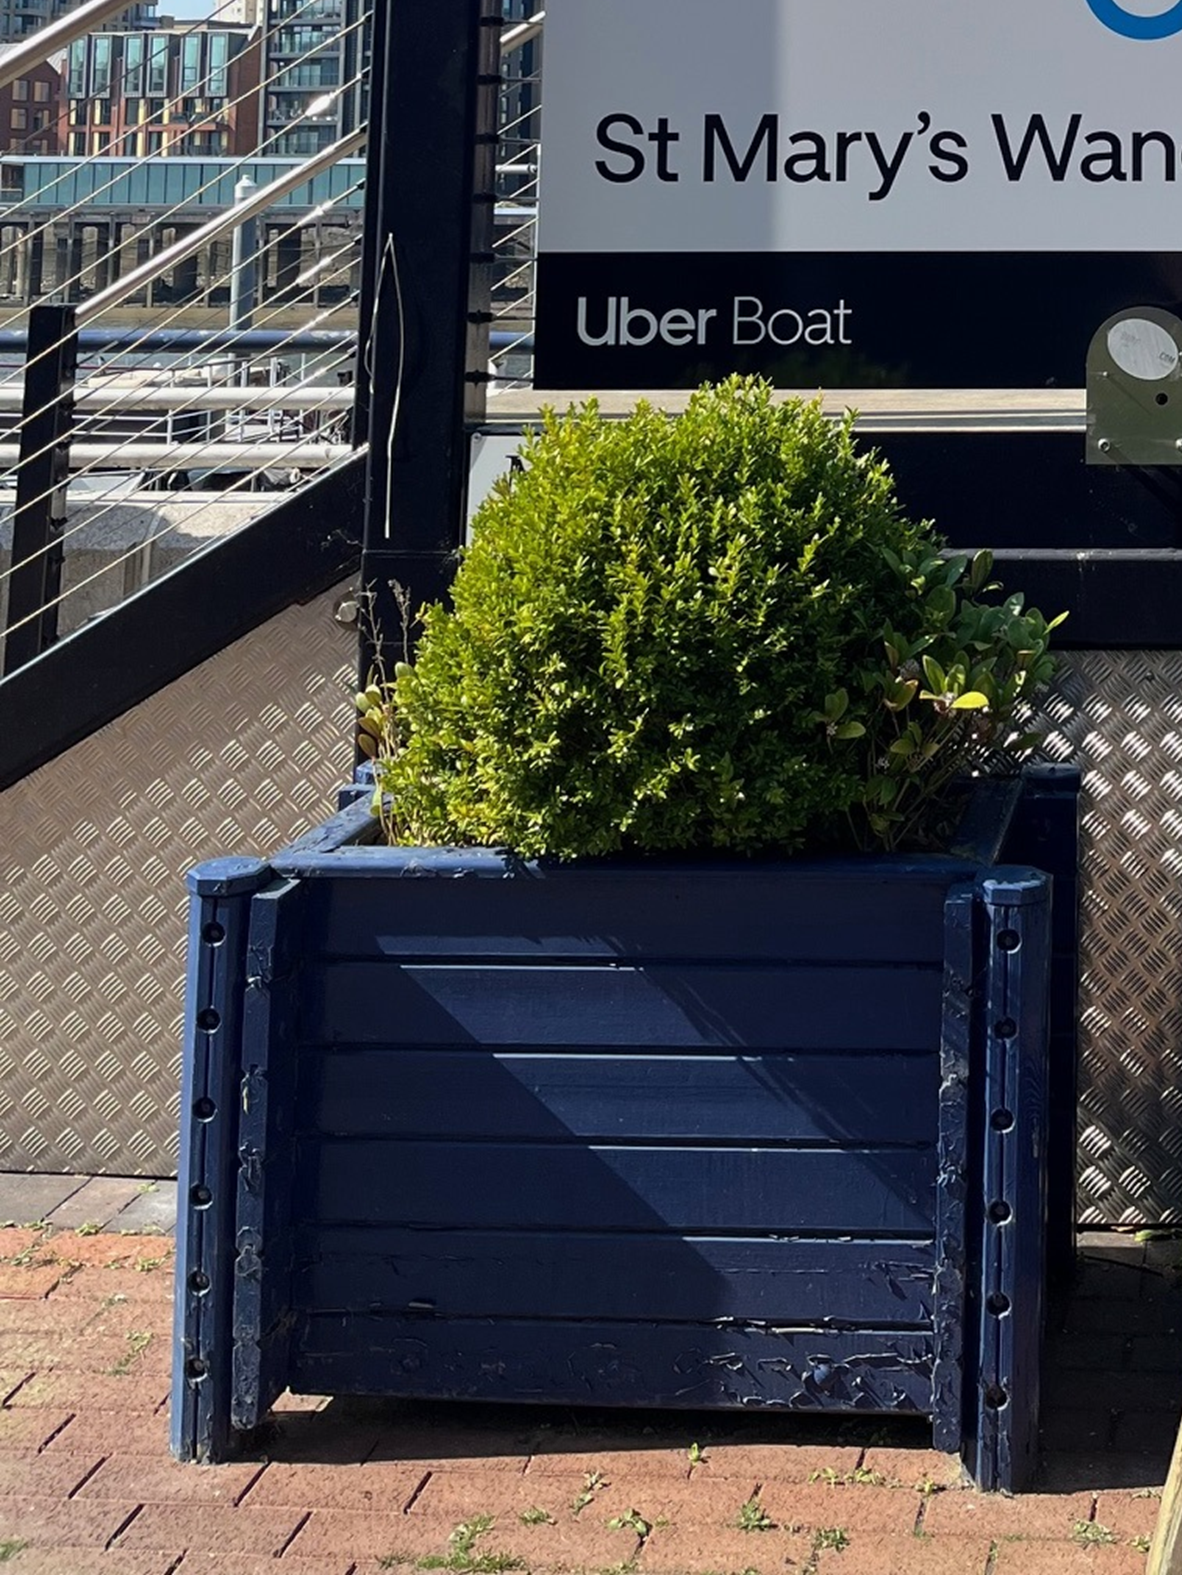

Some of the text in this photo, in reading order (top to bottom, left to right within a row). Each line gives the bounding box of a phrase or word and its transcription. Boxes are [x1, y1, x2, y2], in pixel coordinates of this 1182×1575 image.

[594, 112, 680, 184] St
[703, 111, 969, 201] Mary’s
[577, 296, 853, 346] Uber Boat
